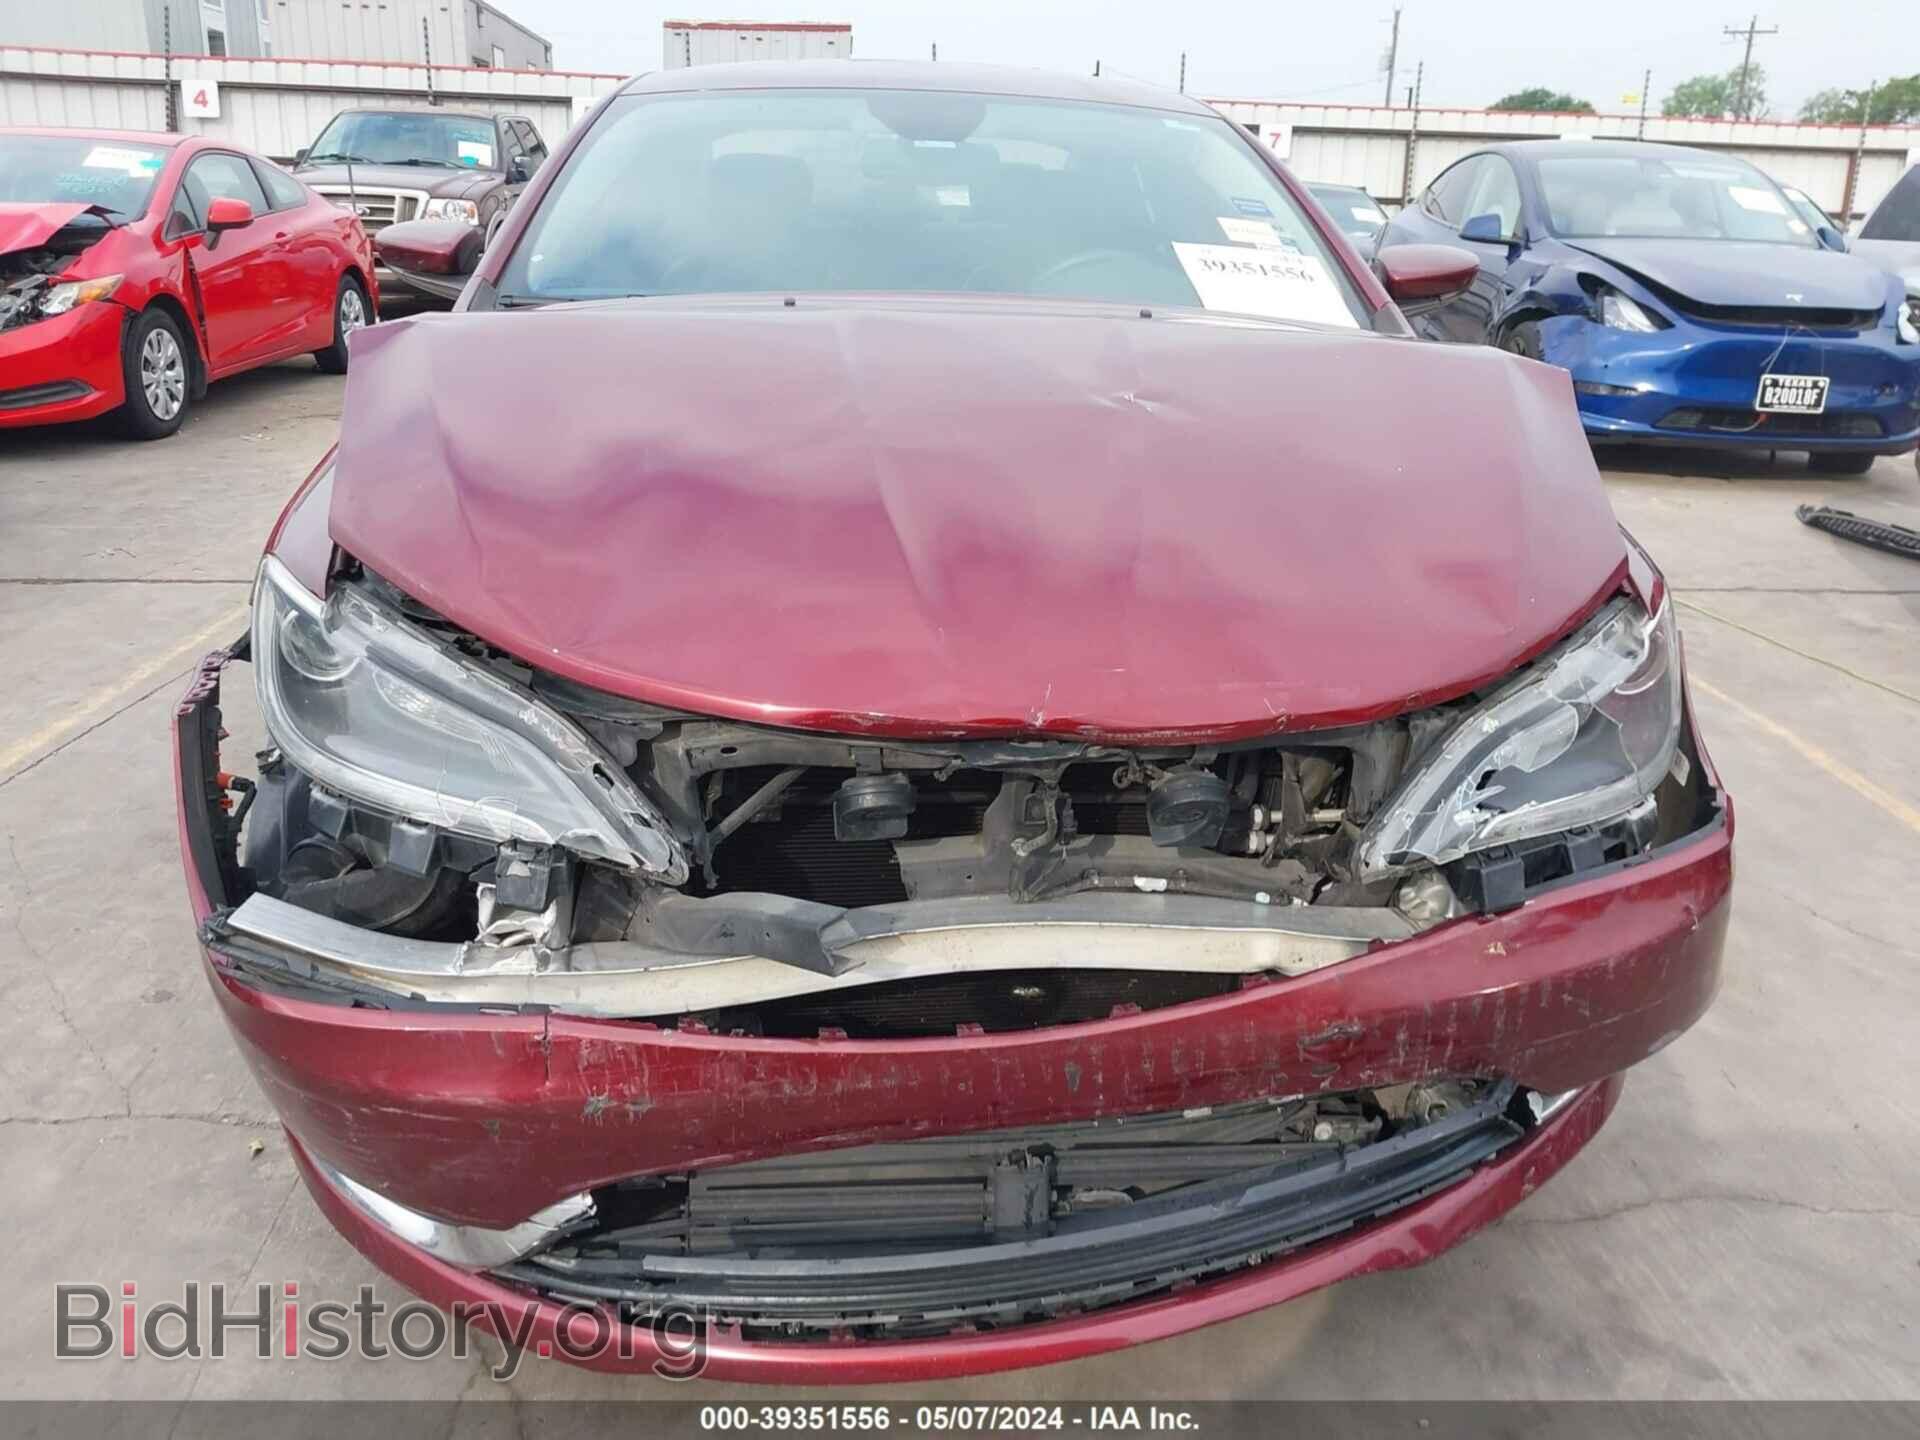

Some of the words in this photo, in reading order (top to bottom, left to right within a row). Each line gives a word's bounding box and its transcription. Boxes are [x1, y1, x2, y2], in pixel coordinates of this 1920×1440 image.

[192, 89, 209, 108] 4
[1269, 132, 1282, 149] 7
[1198, 257, 1315, 285] 39351556
[1778, 378, 1813, 387] TEXAS
